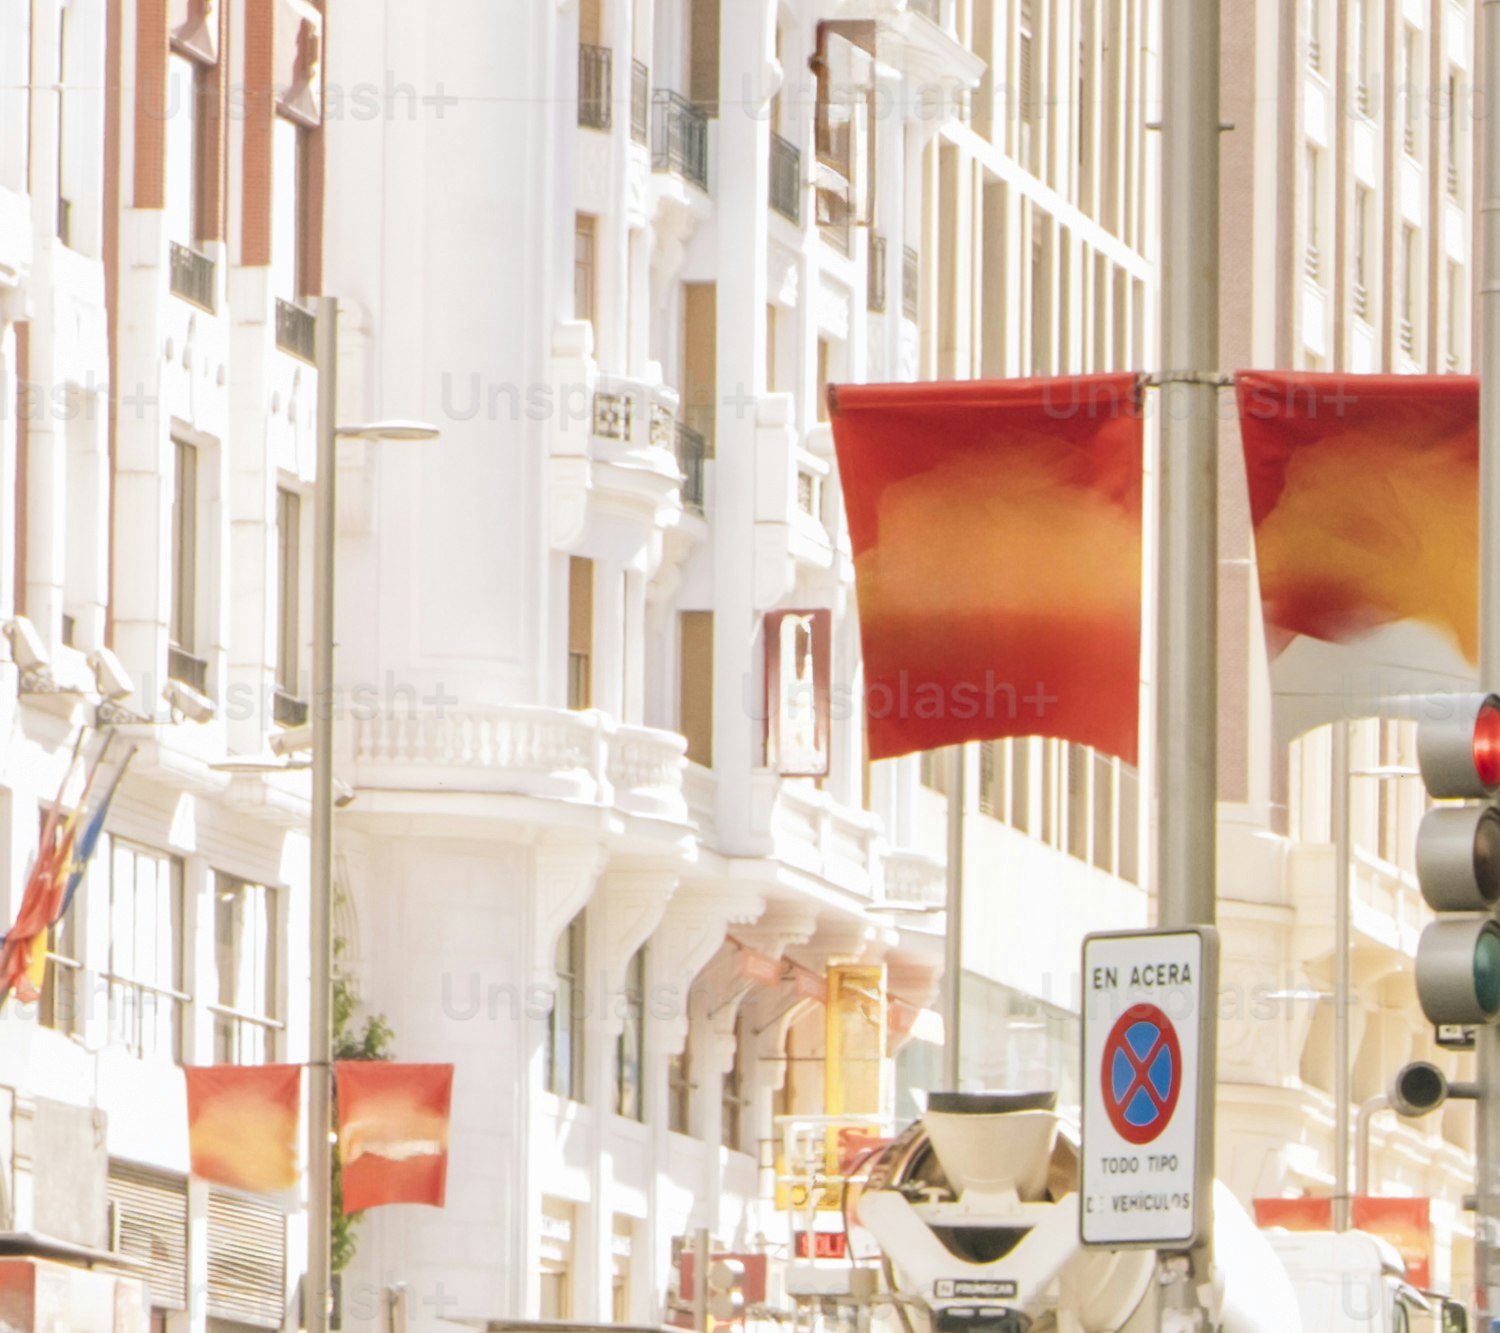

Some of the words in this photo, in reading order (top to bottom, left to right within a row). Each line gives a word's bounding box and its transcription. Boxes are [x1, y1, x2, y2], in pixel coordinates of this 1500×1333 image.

[1093, 967, 1118, 989] EN
[1130, 962, 1192, 987] ACERA
[1101, 1156, 1140, 1175] TODO
[1147, 1154, 1179, 1173] TIPO
